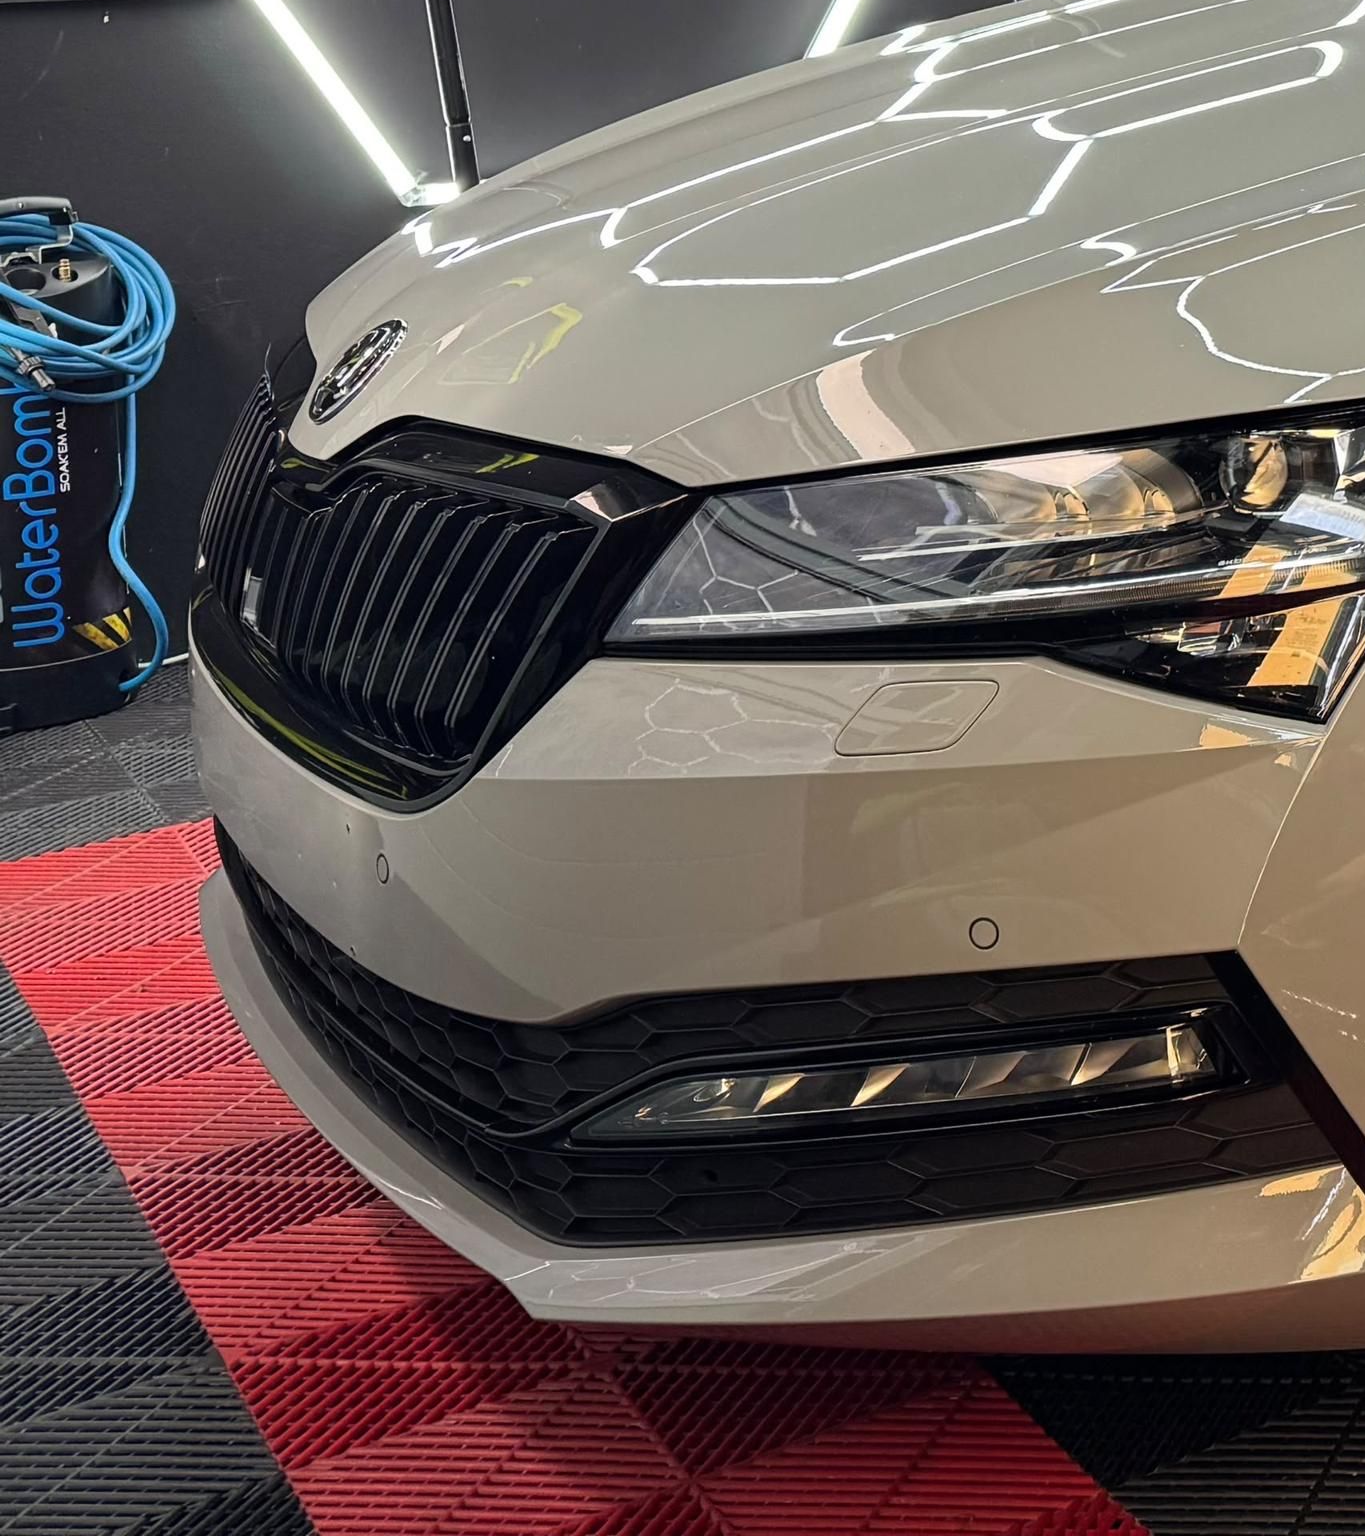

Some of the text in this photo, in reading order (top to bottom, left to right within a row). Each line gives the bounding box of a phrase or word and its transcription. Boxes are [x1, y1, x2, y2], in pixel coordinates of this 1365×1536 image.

[0, 382, 65, 648] WaterBom
[57, 407, 71, 493] SOAK'EM ALL
